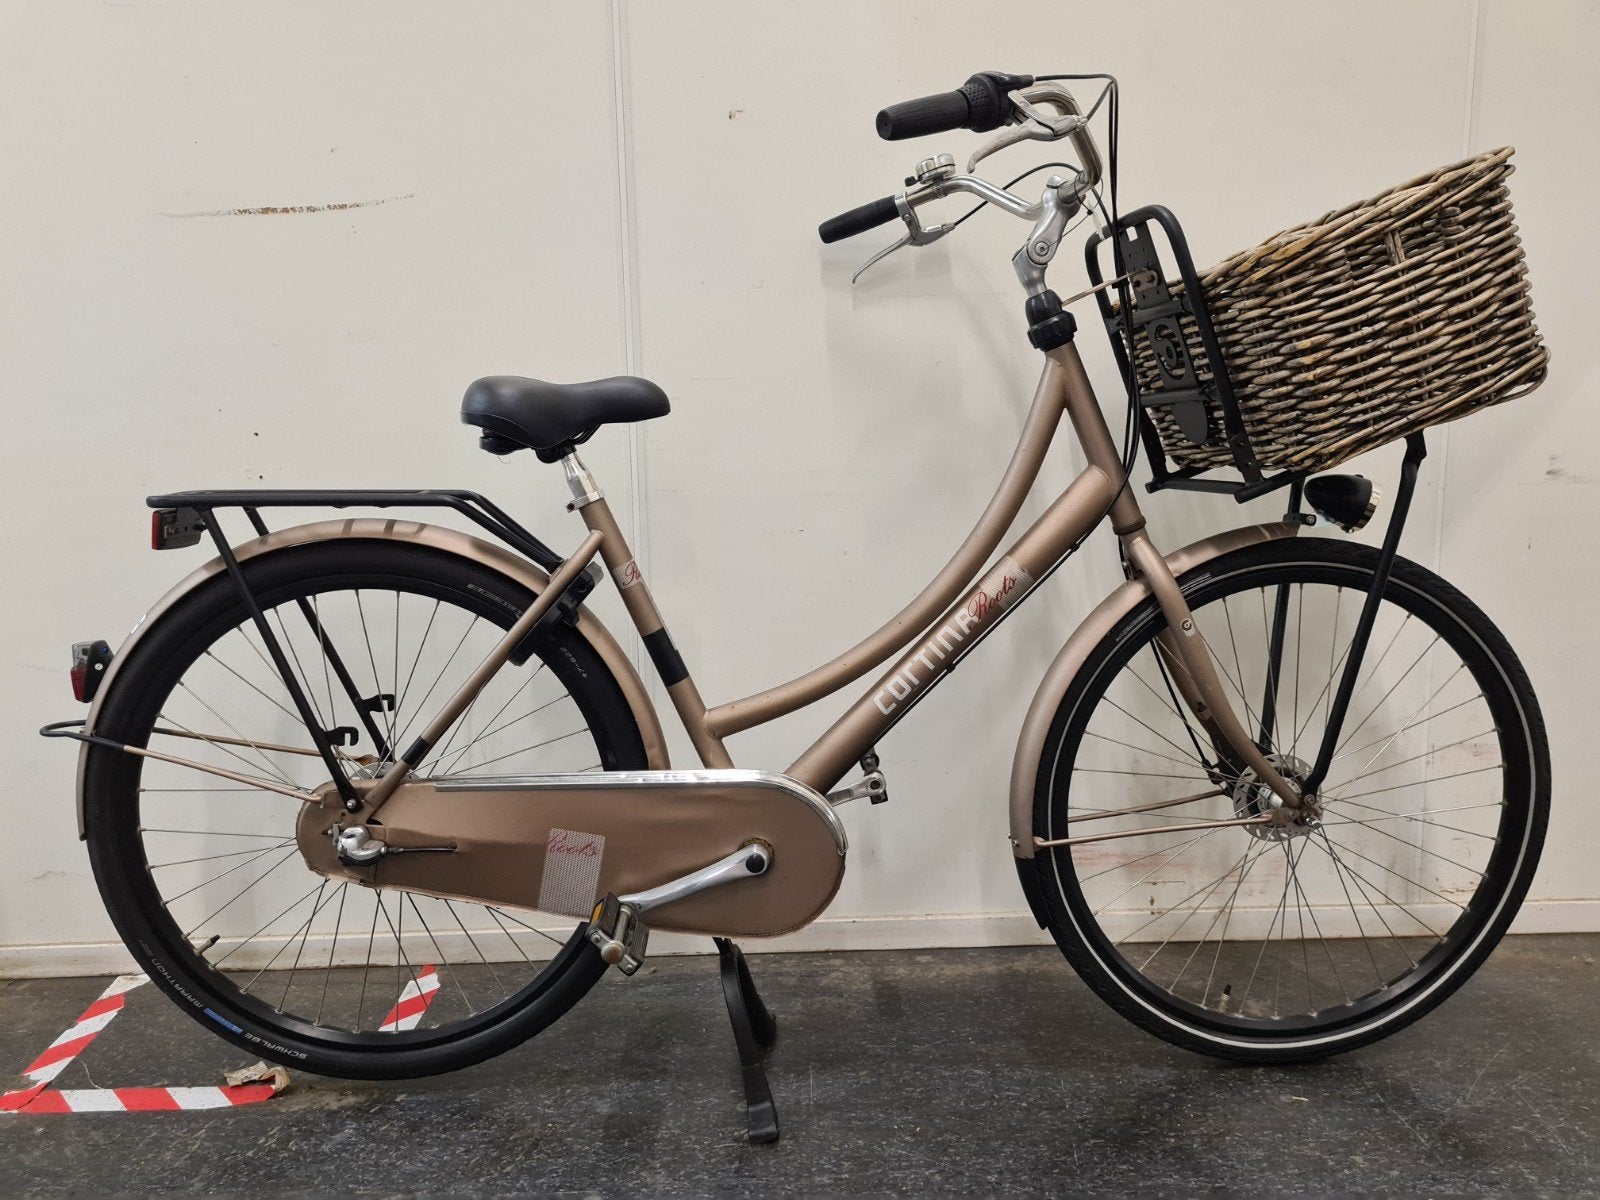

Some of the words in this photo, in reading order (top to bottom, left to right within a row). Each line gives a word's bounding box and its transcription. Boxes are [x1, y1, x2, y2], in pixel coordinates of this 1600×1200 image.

[967, 575, 1018, 629] Roots
[151, 958, 203, 1009] MARATHON
[243, 1032, 308, 1060] SCHWALBE
